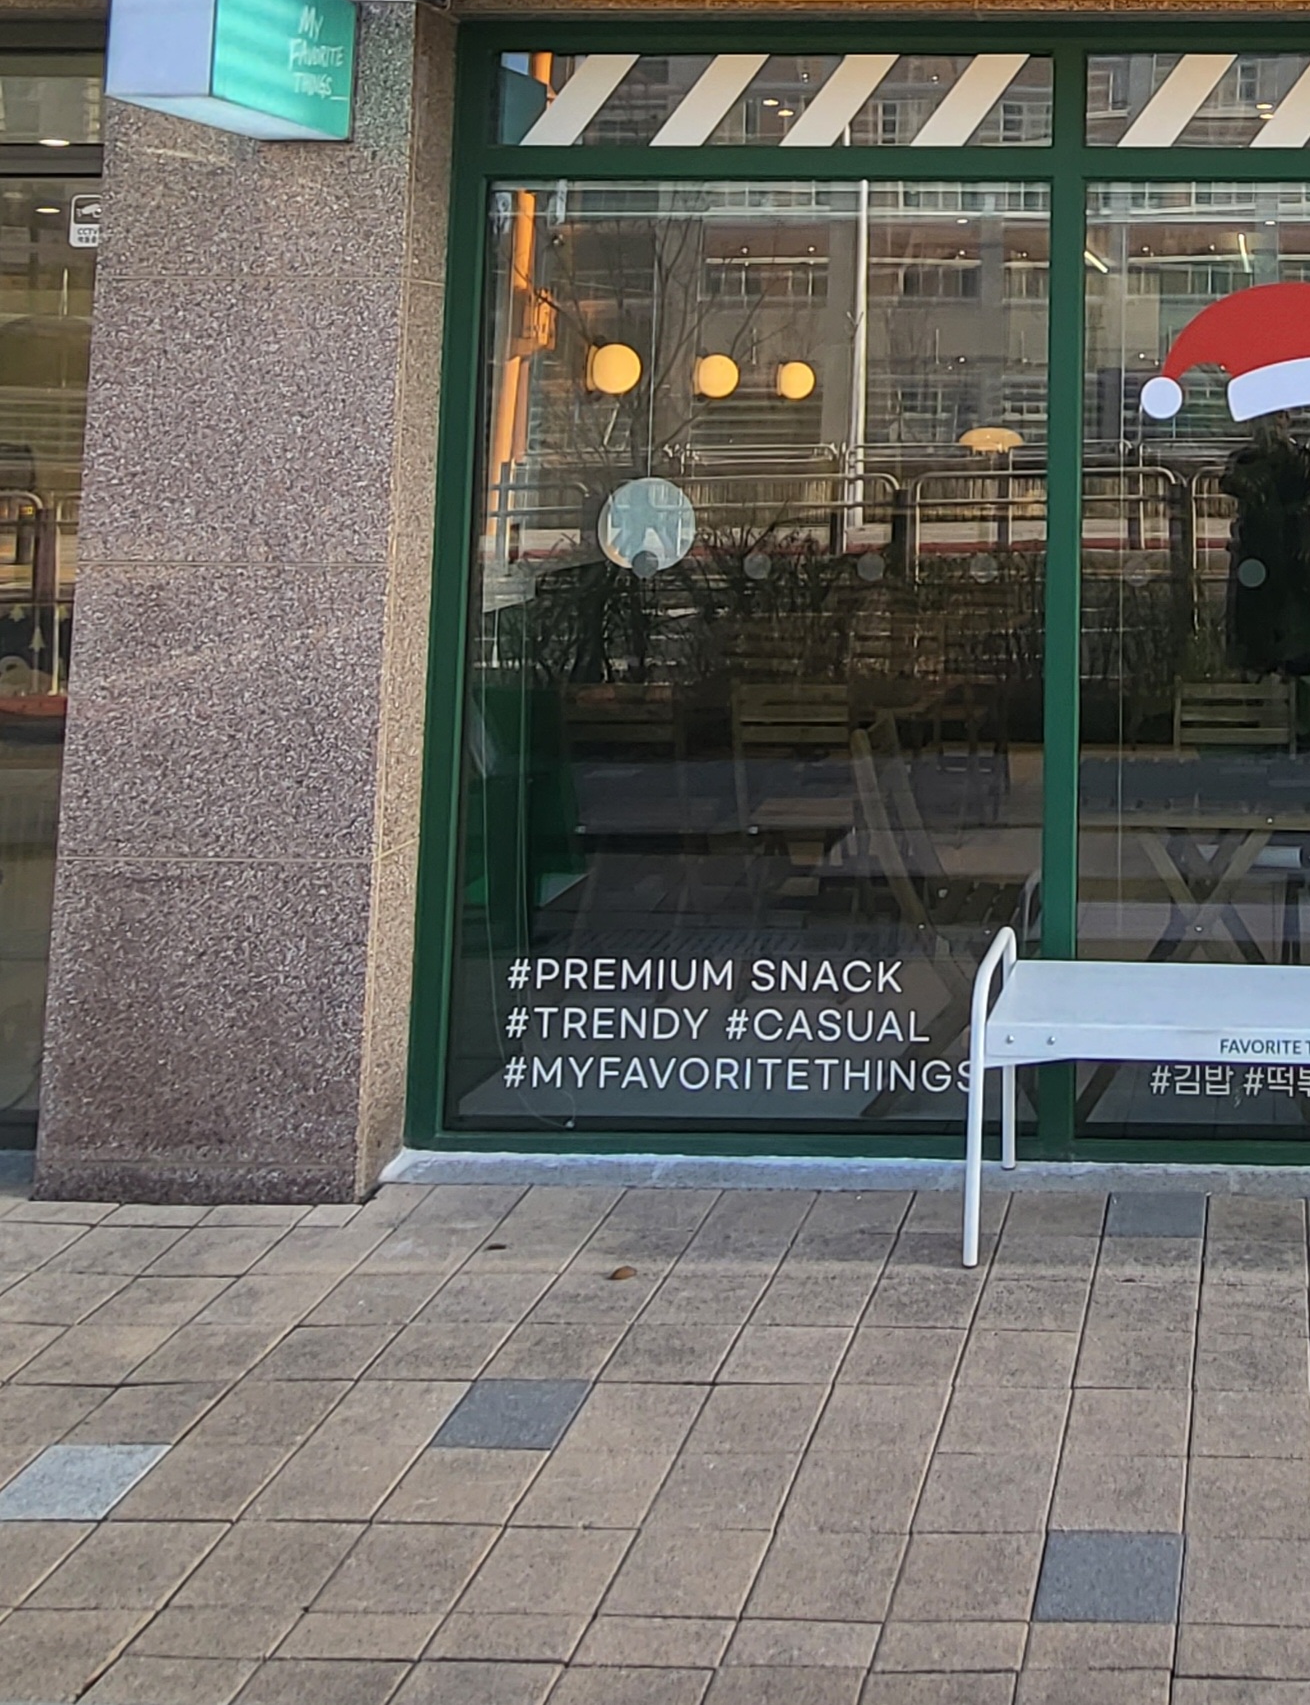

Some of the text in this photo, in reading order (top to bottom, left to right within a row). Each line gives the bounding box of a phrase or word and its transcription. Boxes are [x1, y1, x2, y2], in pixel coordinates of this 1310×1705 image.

[289, 38, 344, 71] FAVORITE
[507, 958, 902, 993] #PREMIUM SNACK
[505, 1007, 930, 1042] #TRENDY #CASUAL
[1219, 1038, 1302, 1055] FAVORITE
[1150, 1065, 1234, 1095] #김밥
